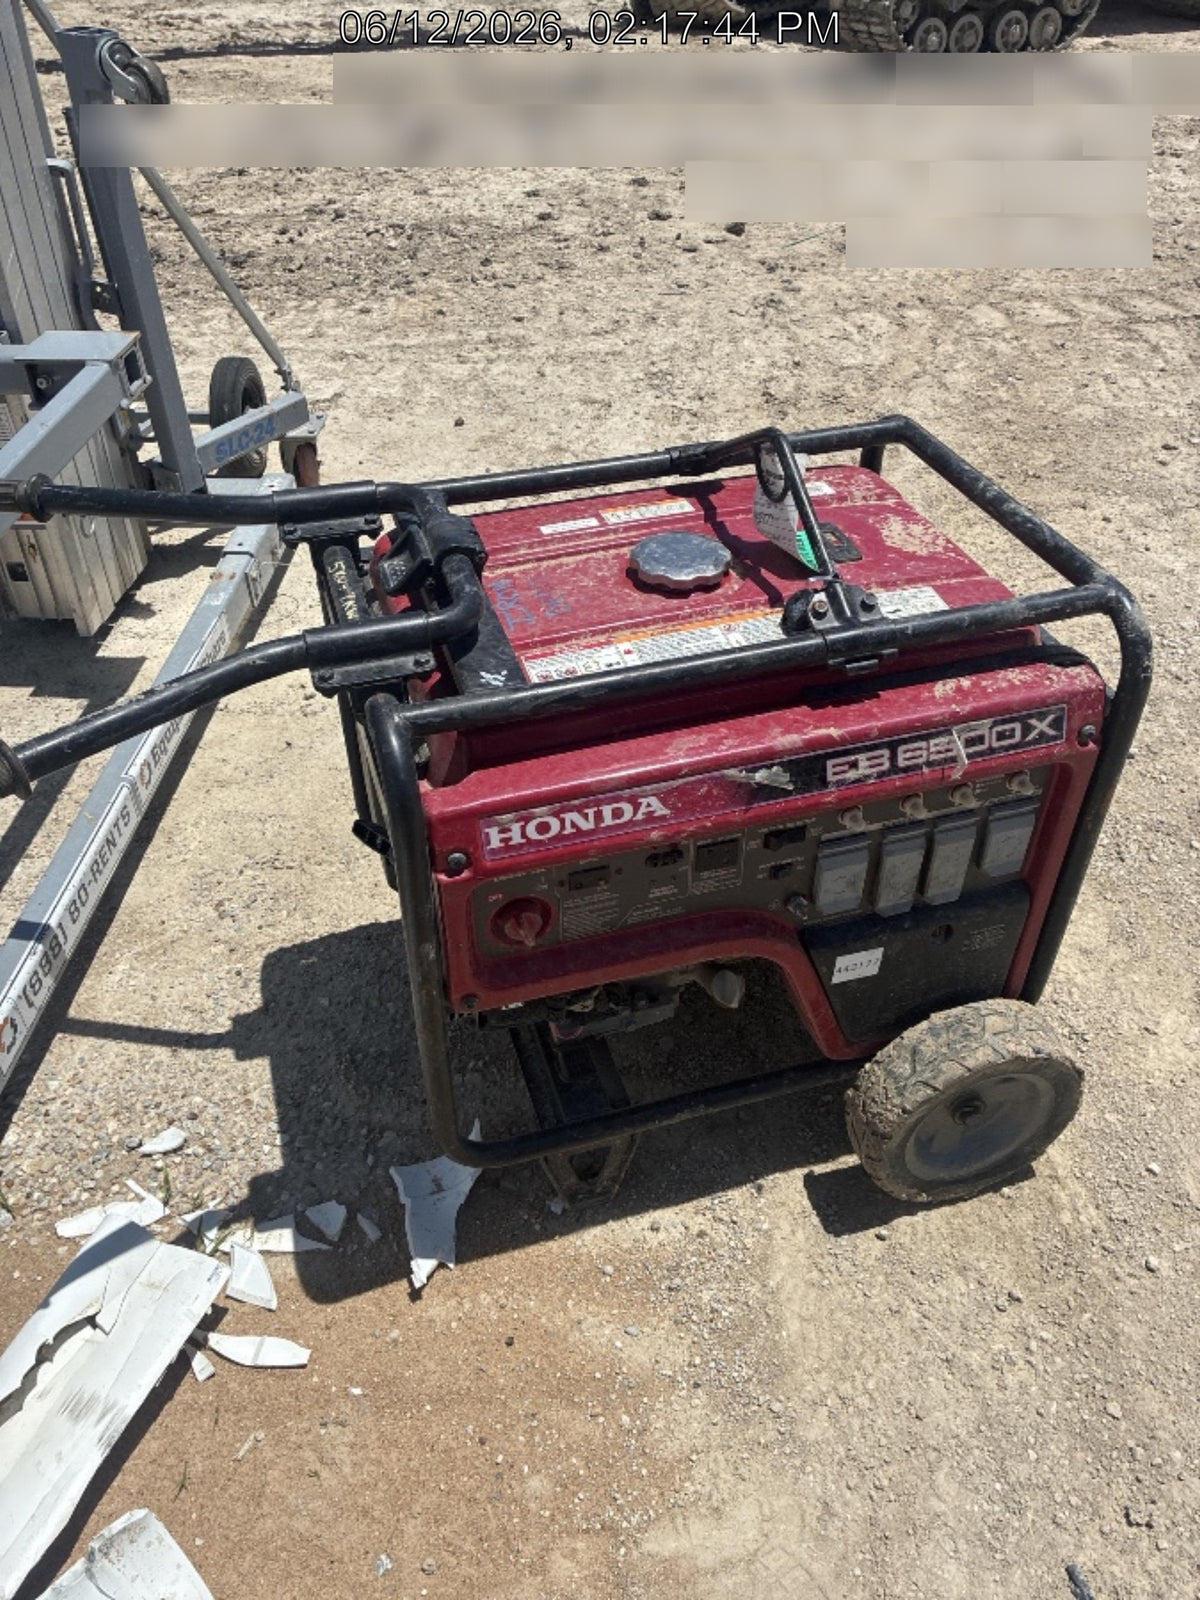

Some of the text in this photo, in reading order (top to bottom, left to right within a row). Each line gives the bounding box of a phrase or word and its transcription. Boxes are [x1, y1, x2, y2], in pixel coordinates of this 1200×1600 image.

[214, 415, 277, 463] SLC-24
[484, 795, 672, 851] HONDA
[67, 804, 132, 927] 80-RENTS
